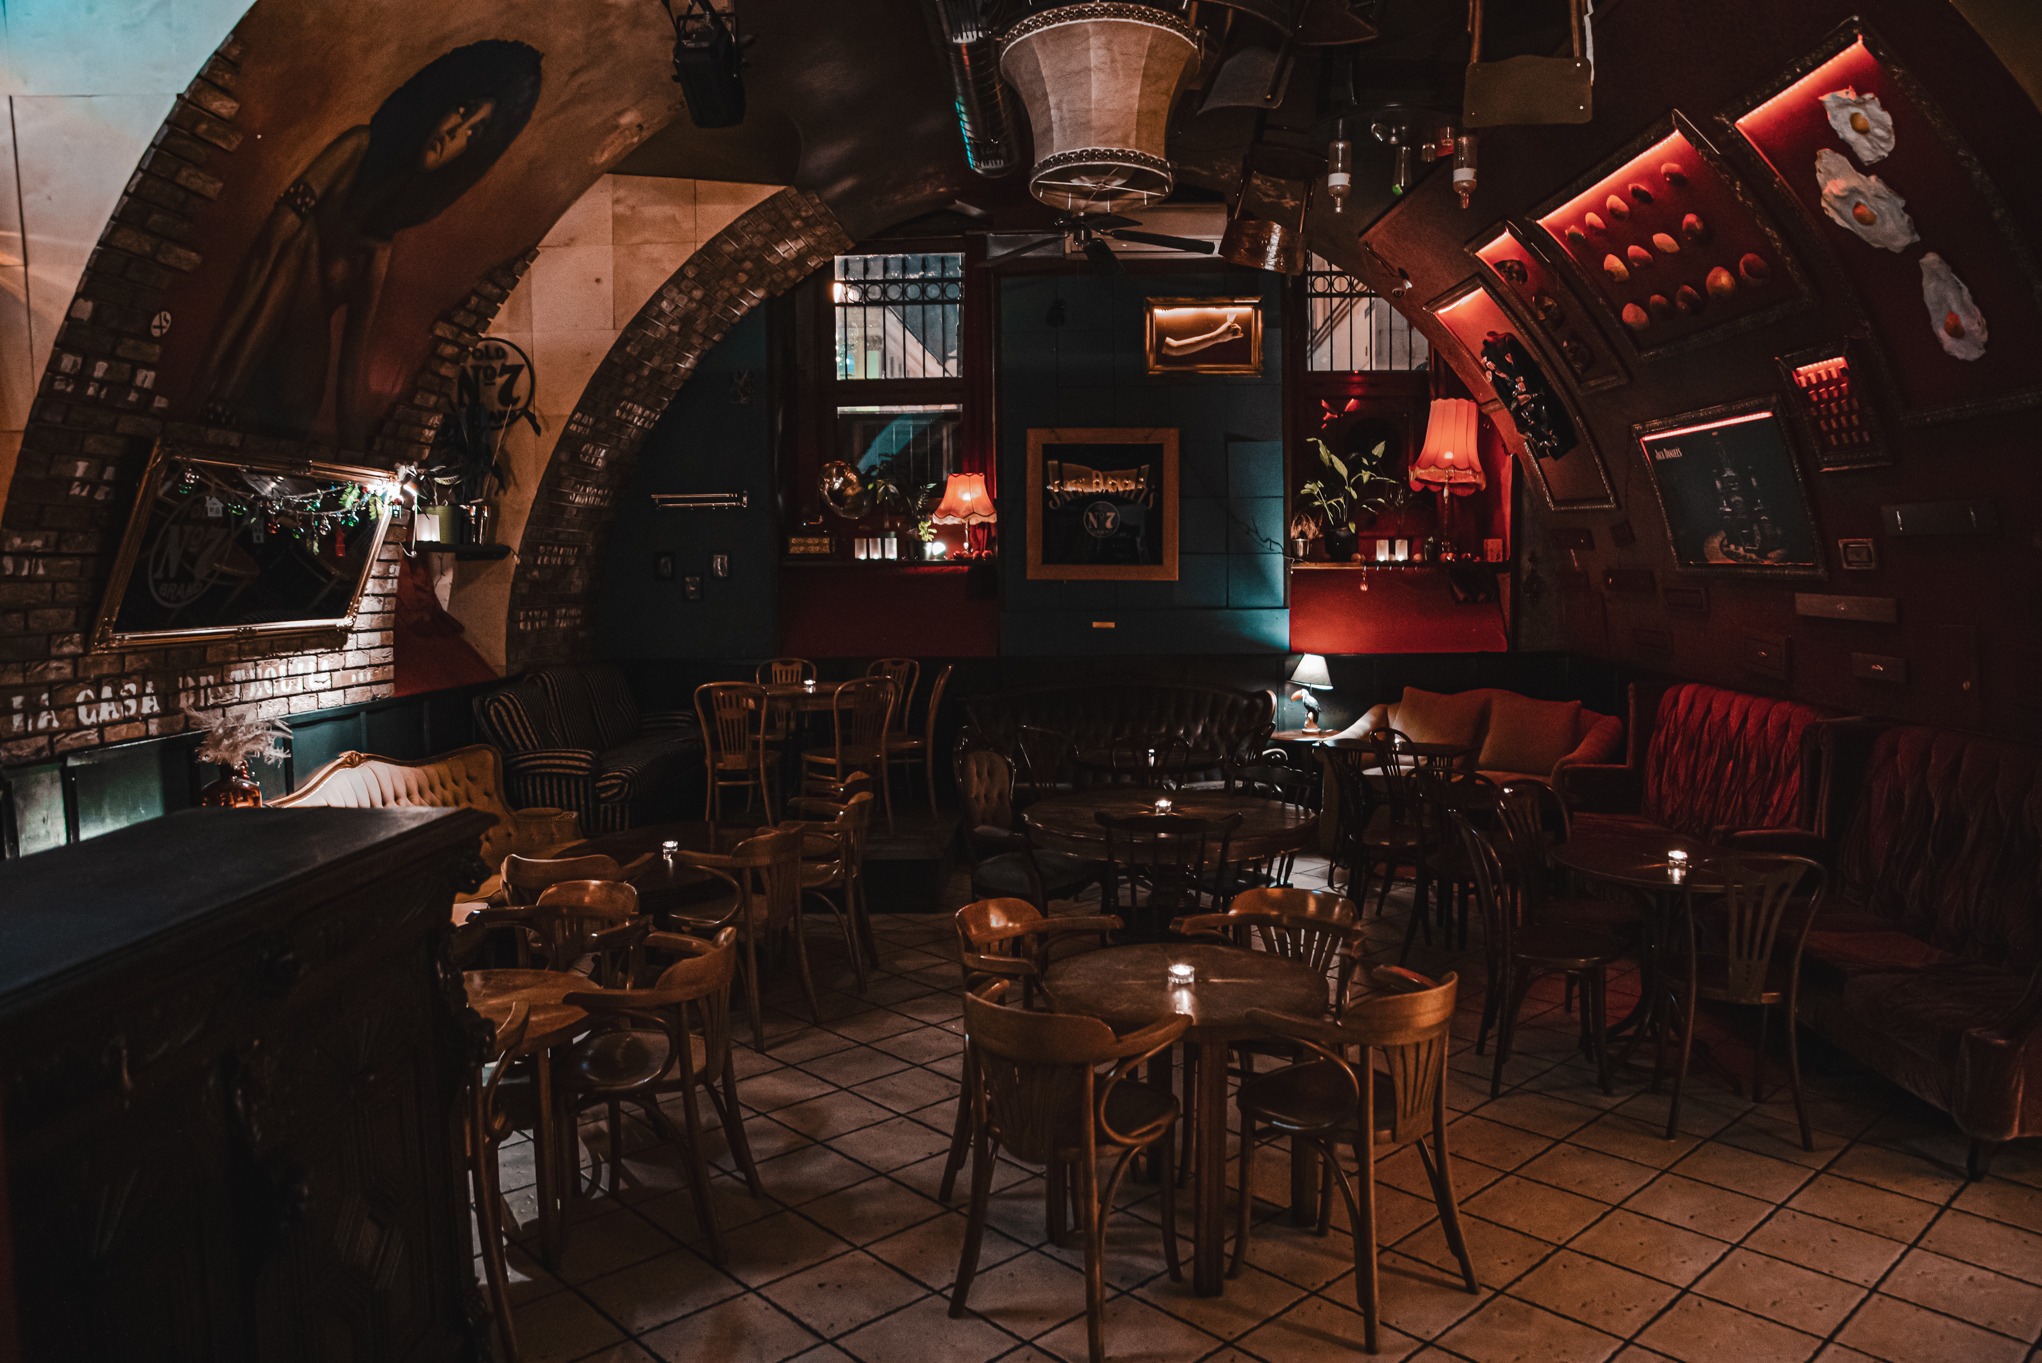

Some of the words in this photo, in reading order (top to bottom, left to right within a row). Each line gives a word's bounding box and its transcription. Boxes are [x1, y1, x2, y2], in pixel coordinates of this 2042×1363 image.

[471, 344, 507, 360] OLD
[10, 692, 60, 732] LA
[76, 681, 162, 727] CASA
